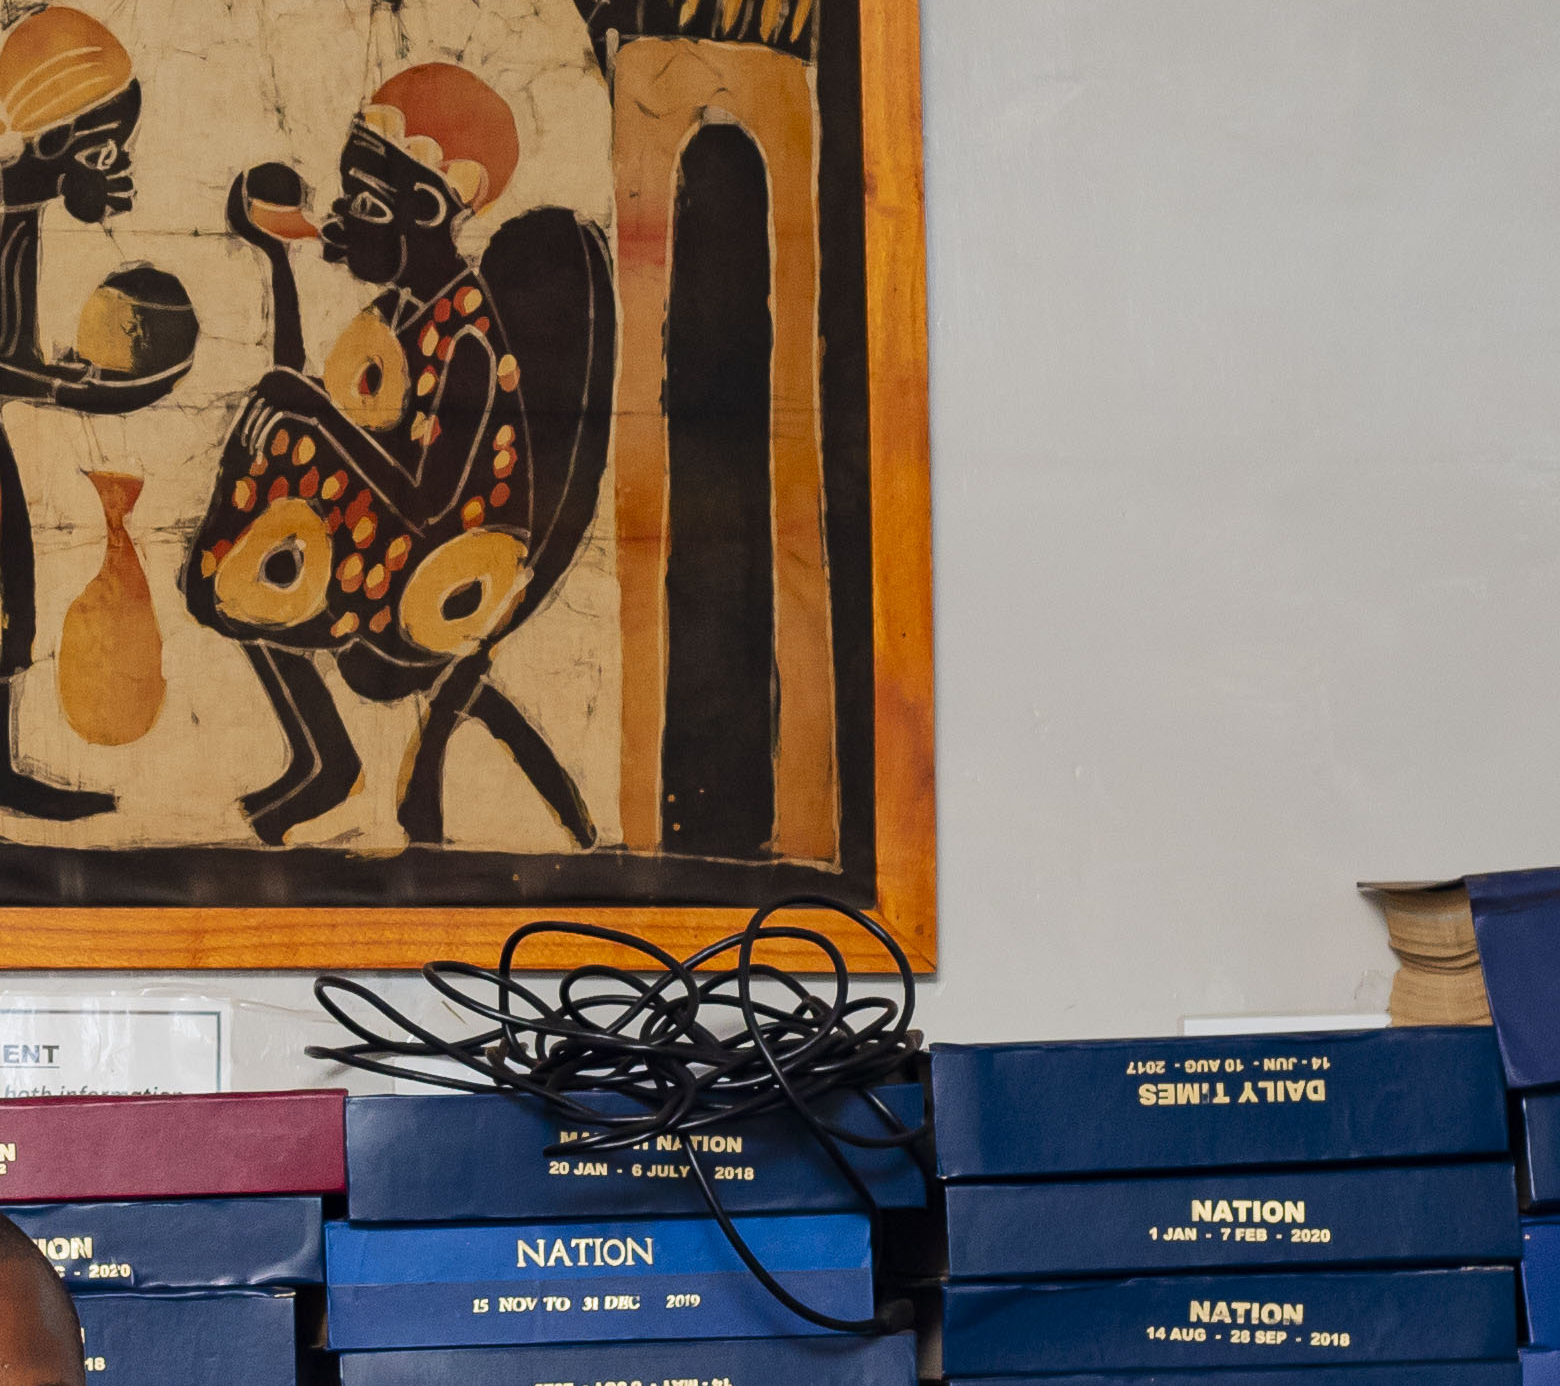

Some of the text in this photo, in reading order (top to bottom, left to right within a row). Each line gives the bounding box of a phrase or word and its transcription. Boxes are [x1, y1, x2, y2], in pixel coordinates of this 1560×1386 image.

[1139, 1080, 1325, 1105] DAILY TIMES
[1192, 1200, 1304, 1223] NATION
[1149, 1227, 1330, 1242] 1 JAN 7 FEB 2020
[517, 1238, 652, 1267] NATION
[473, 1294, 700, 1313] 15 NOV TO 31 DEC 2019
